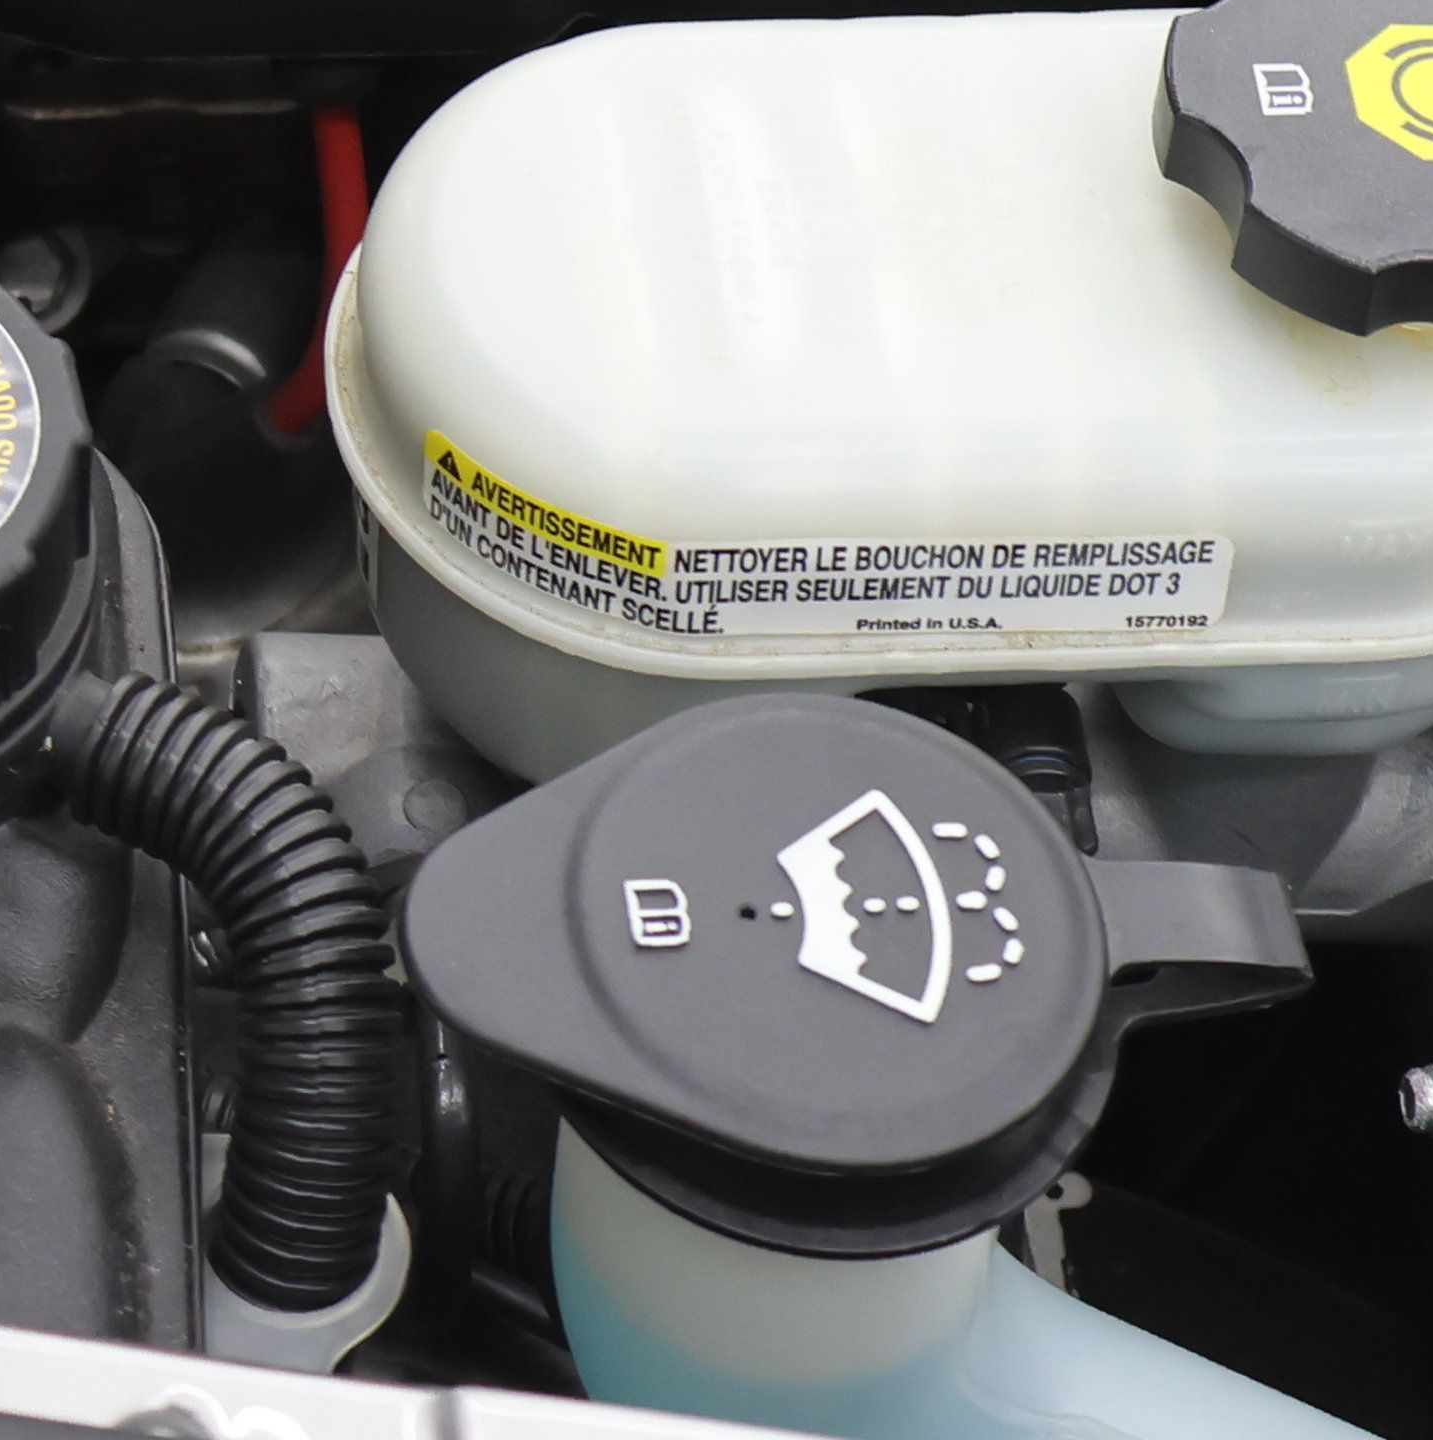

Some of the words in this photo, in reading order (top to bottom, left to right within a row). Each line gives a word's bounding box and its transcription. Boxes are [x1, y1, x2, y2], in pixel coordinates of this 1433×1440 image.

[430, 494, 472, 547] D'UN
[477, 534, 616, 613] CONTENANT
[621, 597, 724, 634] SCELLÉ.
[431, 468, 491, 528] AVANT
[496, 516, 525, 550] DE
[531, 533, 668, 602] L'ENLEVER.
[675, 578, 788, 604] UTILISER
[795, 576, 950, 602] SEULEMENT
[957, 576, 993, 599] DU
[1000, 573, 1102, 598] LIQUIDE
[1108, 573, 1161, 596] DOT
[1165, 572, 1181, 595] 3
[471, 470, 662, 569] AVERTISSEMENT
[674, 547, 808, 573] NETTOYER
[814, 546, 847, 572] LE
[854, 543, 984, 570] BOUCHON
[991, 544, 1026, 569] DE
[1033, 540, 1215, 569] REMPLISSAGE
[856, 616, 921, 631] Printed
[926, 616, 944, 630] in
[949, 616, 1003, 630] U.S.A.
[1125, 615, 1208, 628] 15770192
